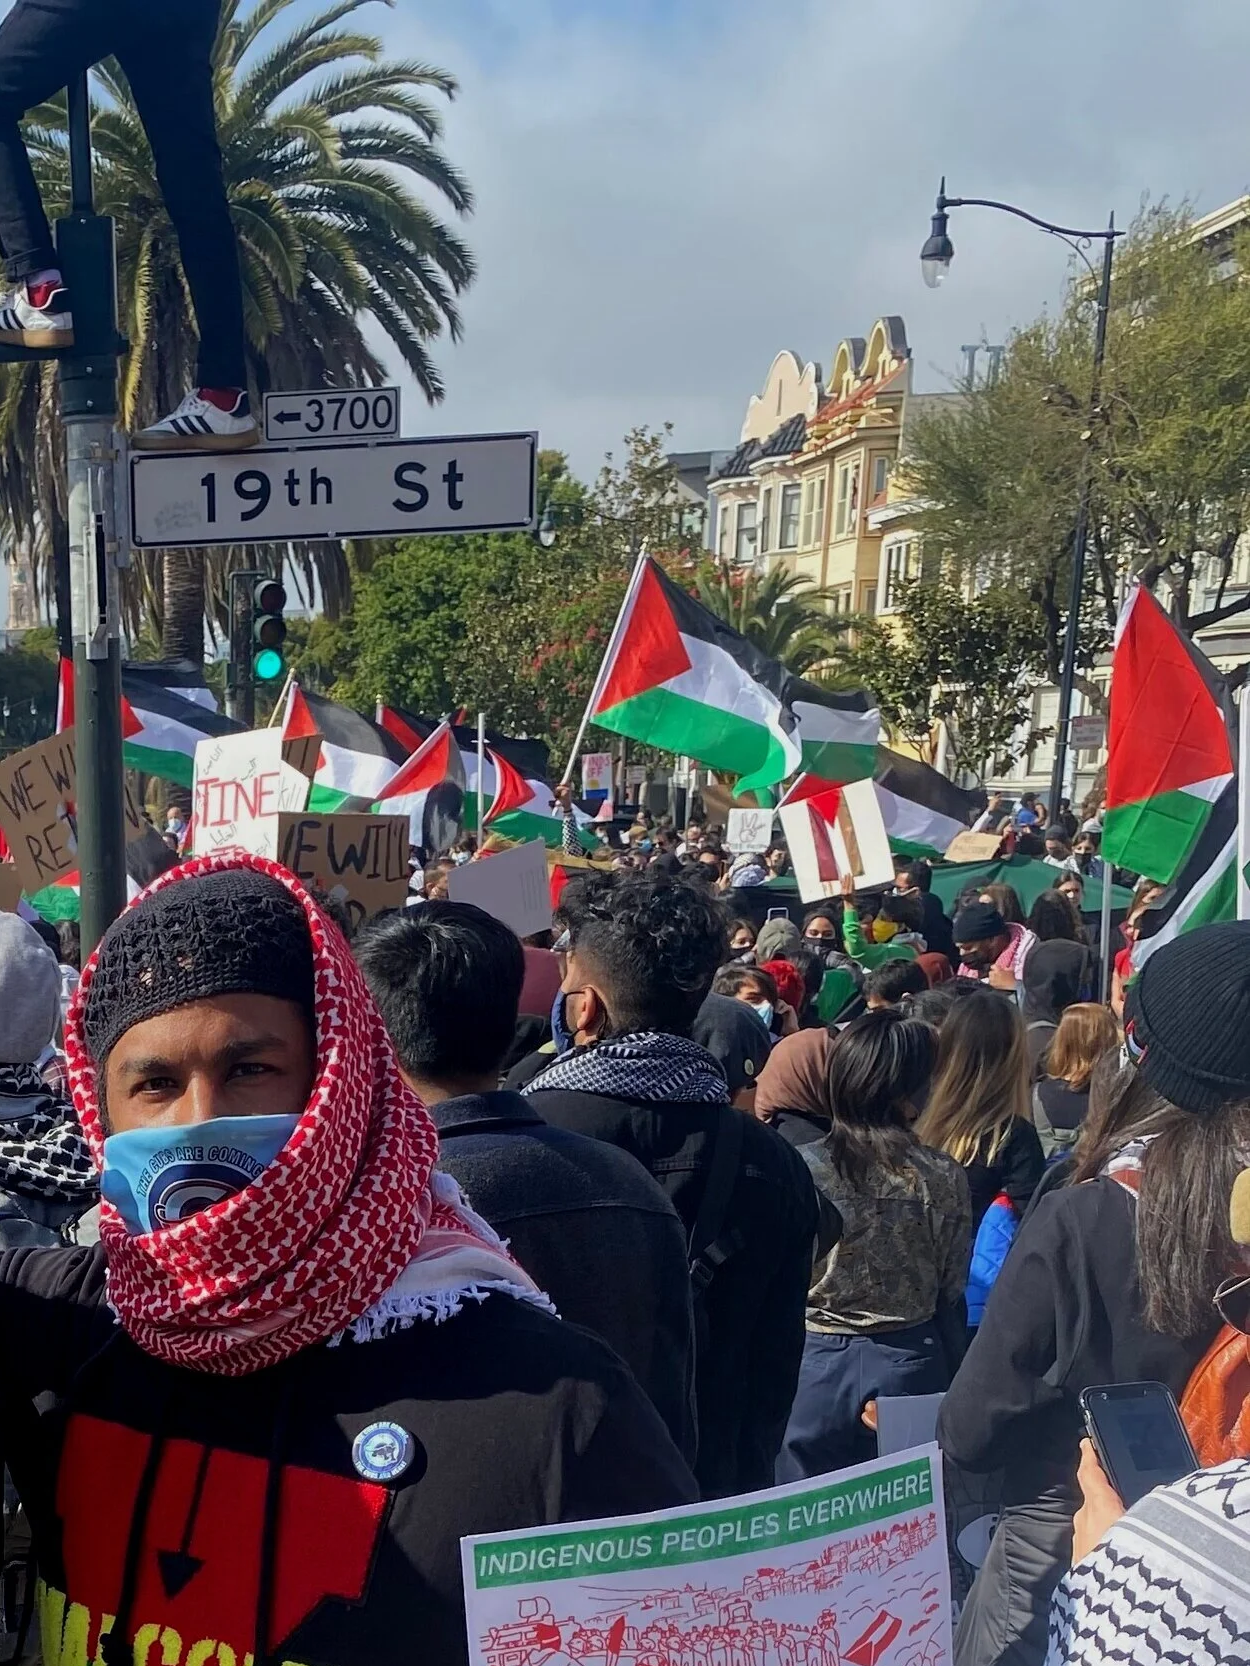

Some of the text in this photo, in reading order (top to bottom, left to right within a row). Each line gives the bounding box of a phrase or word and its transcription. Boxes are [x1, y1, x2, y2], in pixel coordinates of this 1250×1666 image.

[305, 395, 393, 434] 3700
[200, 459, 464, 524] 19th St
[136, 1167, 153, 1198] THE
[148, 1148, 174, 1174] CUBS
[176, 1147, 205, 1162] ARE
[479, 1470, 931, 1577] INDIGENOUS PEOPLES EVERYWHERE
